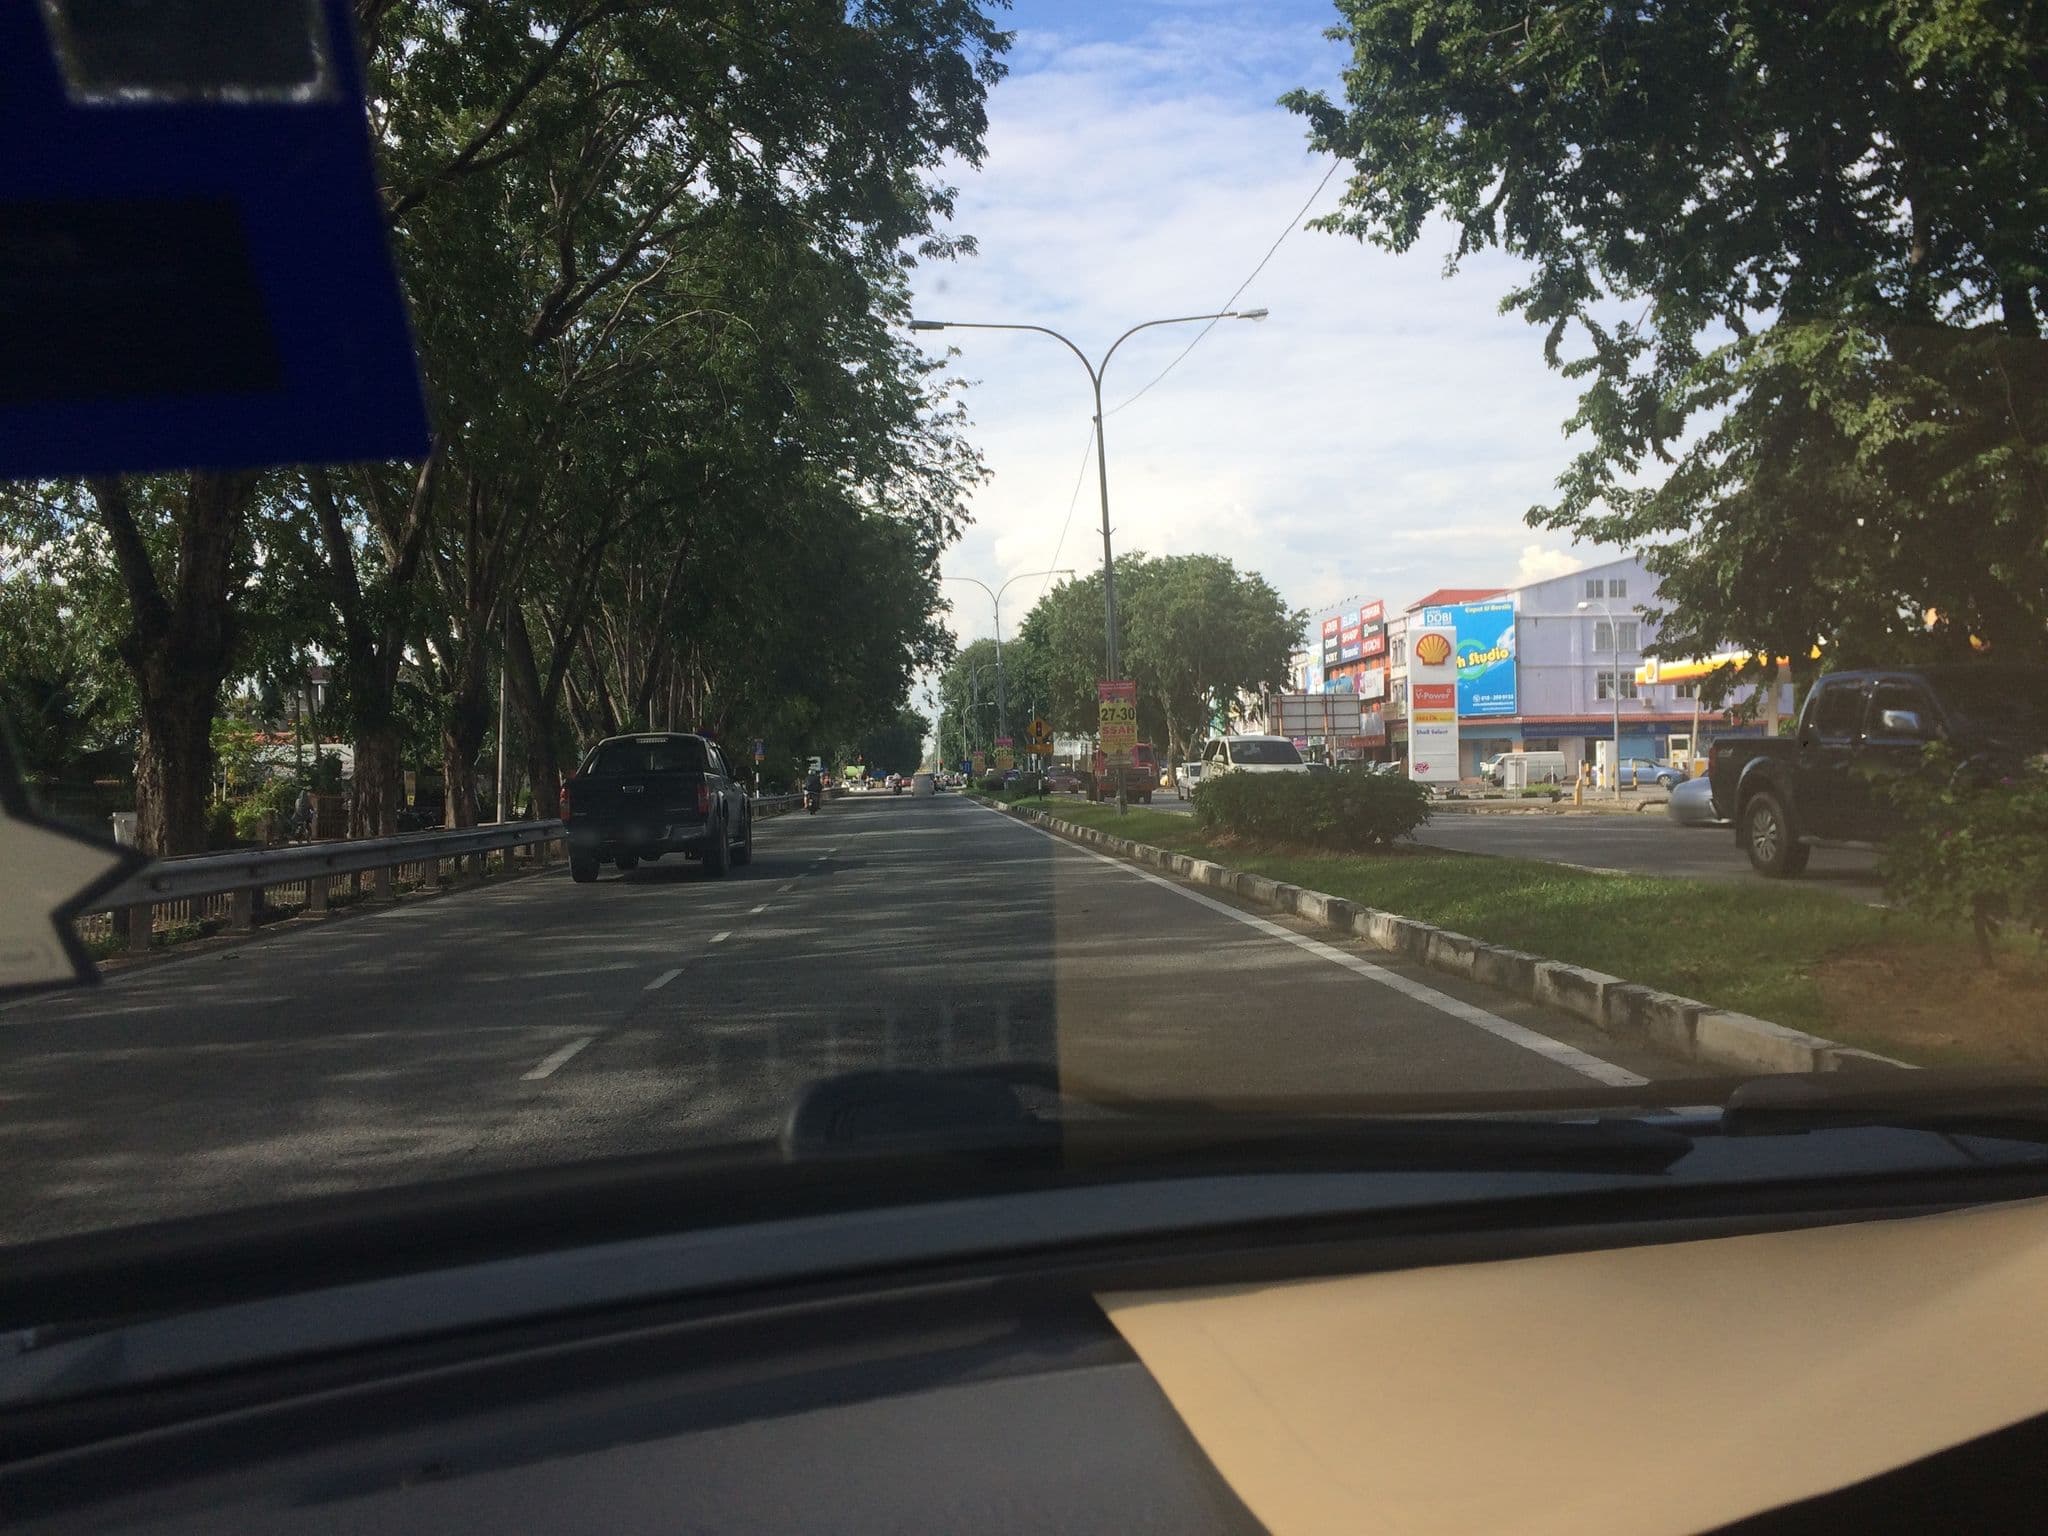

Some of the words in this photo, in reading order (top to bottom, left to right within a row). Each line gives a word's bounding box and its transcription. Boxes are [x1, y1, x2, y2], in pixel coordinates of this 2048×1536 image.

[1426, 612, 1452, 623] DOBI
[1469, 647, 1509, 666] Studio
[1101, 707, 1135, 721] 27-30
